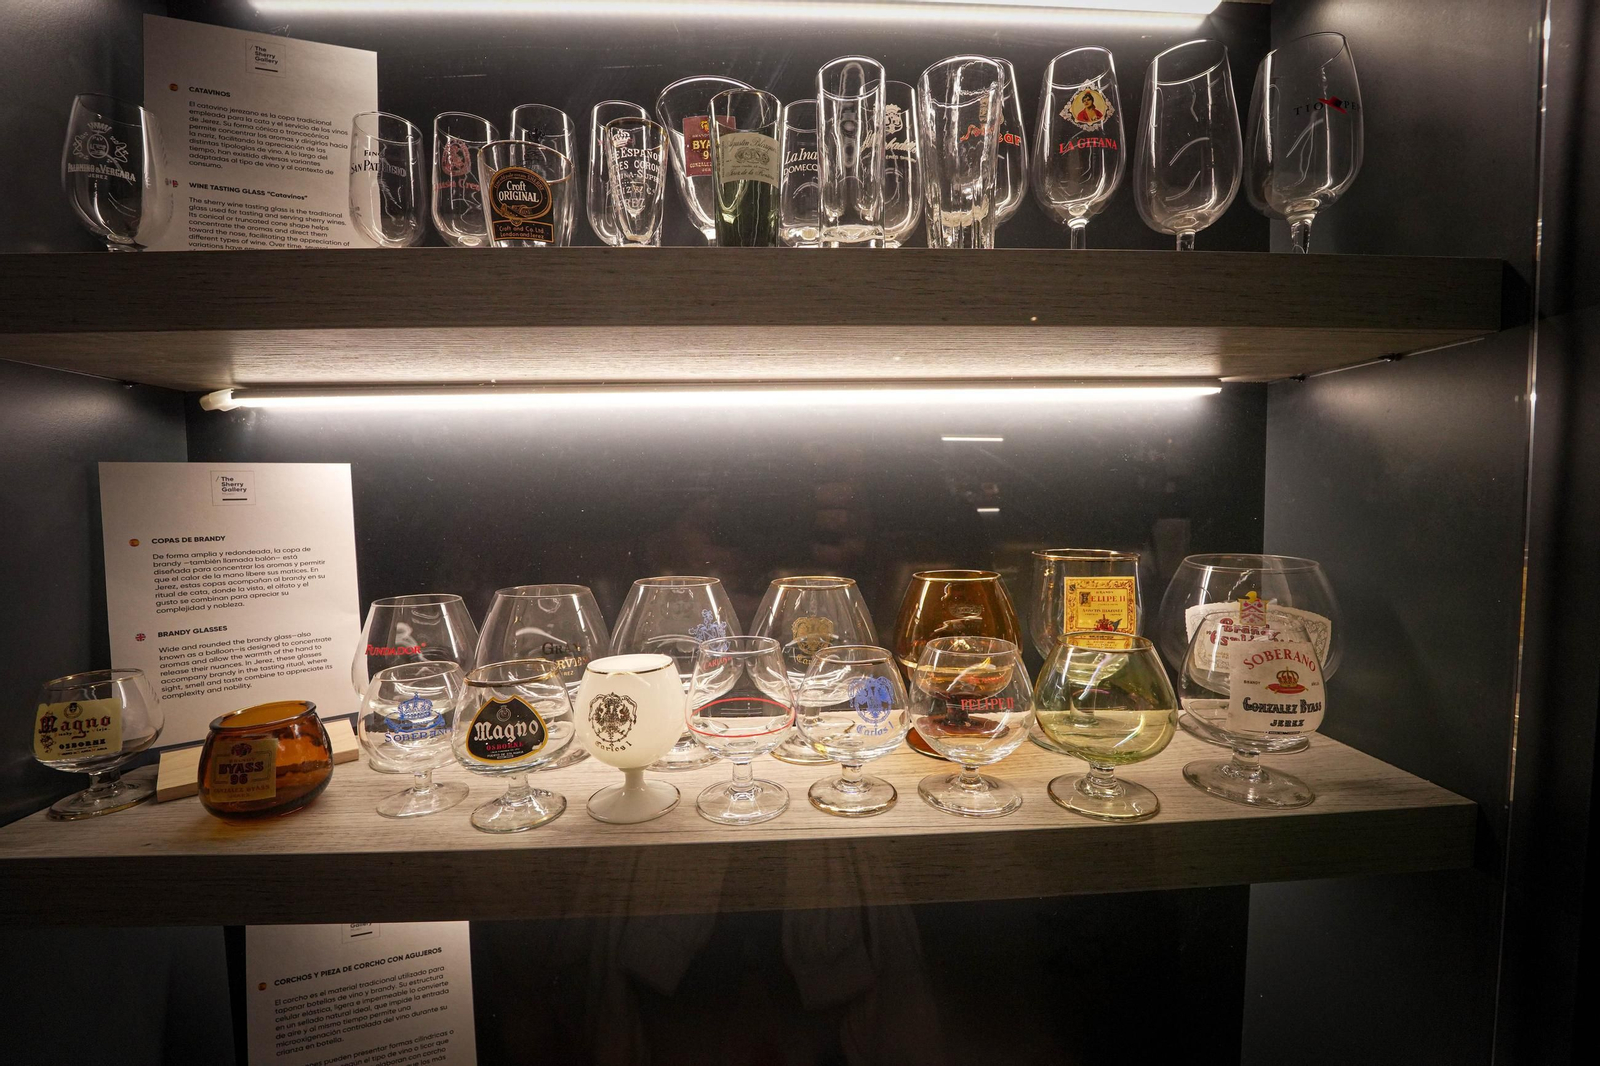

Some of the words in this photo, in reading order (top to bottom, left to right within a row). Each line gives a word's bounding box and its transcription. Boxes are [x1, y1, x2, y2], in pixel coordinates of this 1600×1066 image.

[255, 51, 275, 59] Sherry
[255, 56, 278, 65] Gallery
[188, 86, 230, 97] CATAVINOS
[196, 103, 228, 111] catavino
[229, 106, 259, 116] jerezano
[296, 116, 332, 126] tradicional
[1293, 102, 1324, 115] TIO
[1059, 141, 1074, 154] LA
[1077, 138, 1118, 150] GITANA
[785, 151, 798, 164] La
[798, 148, 818, 161] Ina
[99, 164, 136, 182] VERGARA
[209, 184, 240, 192] TASTING
[506, 180, 526, 191] Croft
[498, 191, 539, 203] ORIGINAL
[203, 198, 226, 207] sherry
[244, 202, 269, 211] tasting
[308, 209, 342, 218] traditional
[244, 649, 272, 658] warmth
[1243, 649, 1316, 672] SOBERANO
[961, 698, 1005, 710] FELIPE
[1243, 697, 1297, 714] GONZALEZ
[1300, 699, 1322, 714] BYASS
[39, 714, 111, 740] Magno
[474, 720, 539, 743] Magno
[856, 724, 888, 736] Carlos
[59, 739, 106, 749] OSBORNE
[486, 742, 523, 751] OSBORNE
[219, 761, 264, 774] BYASS
[230, 774, 248, 785] 96
[273, 973, 312, 985] CORCHOS
[320, 967, 341, 976] PIEZA
[353, 958, 386, 969] CORCHO
[404, 947, 442, 959] AGUJEROS
[282, 994, 308, 1004] corcho
[327, 983, 357, 994] material
[358, 975, 396, 988] tradicional
[397, 969, 427, 979] utilizado
[427, 966, 444, 974] para
[274, 1004, 305, 1014] taponar
[306, 997, 336, 1007] botellas
[408, 974, 443, 985] estructura
